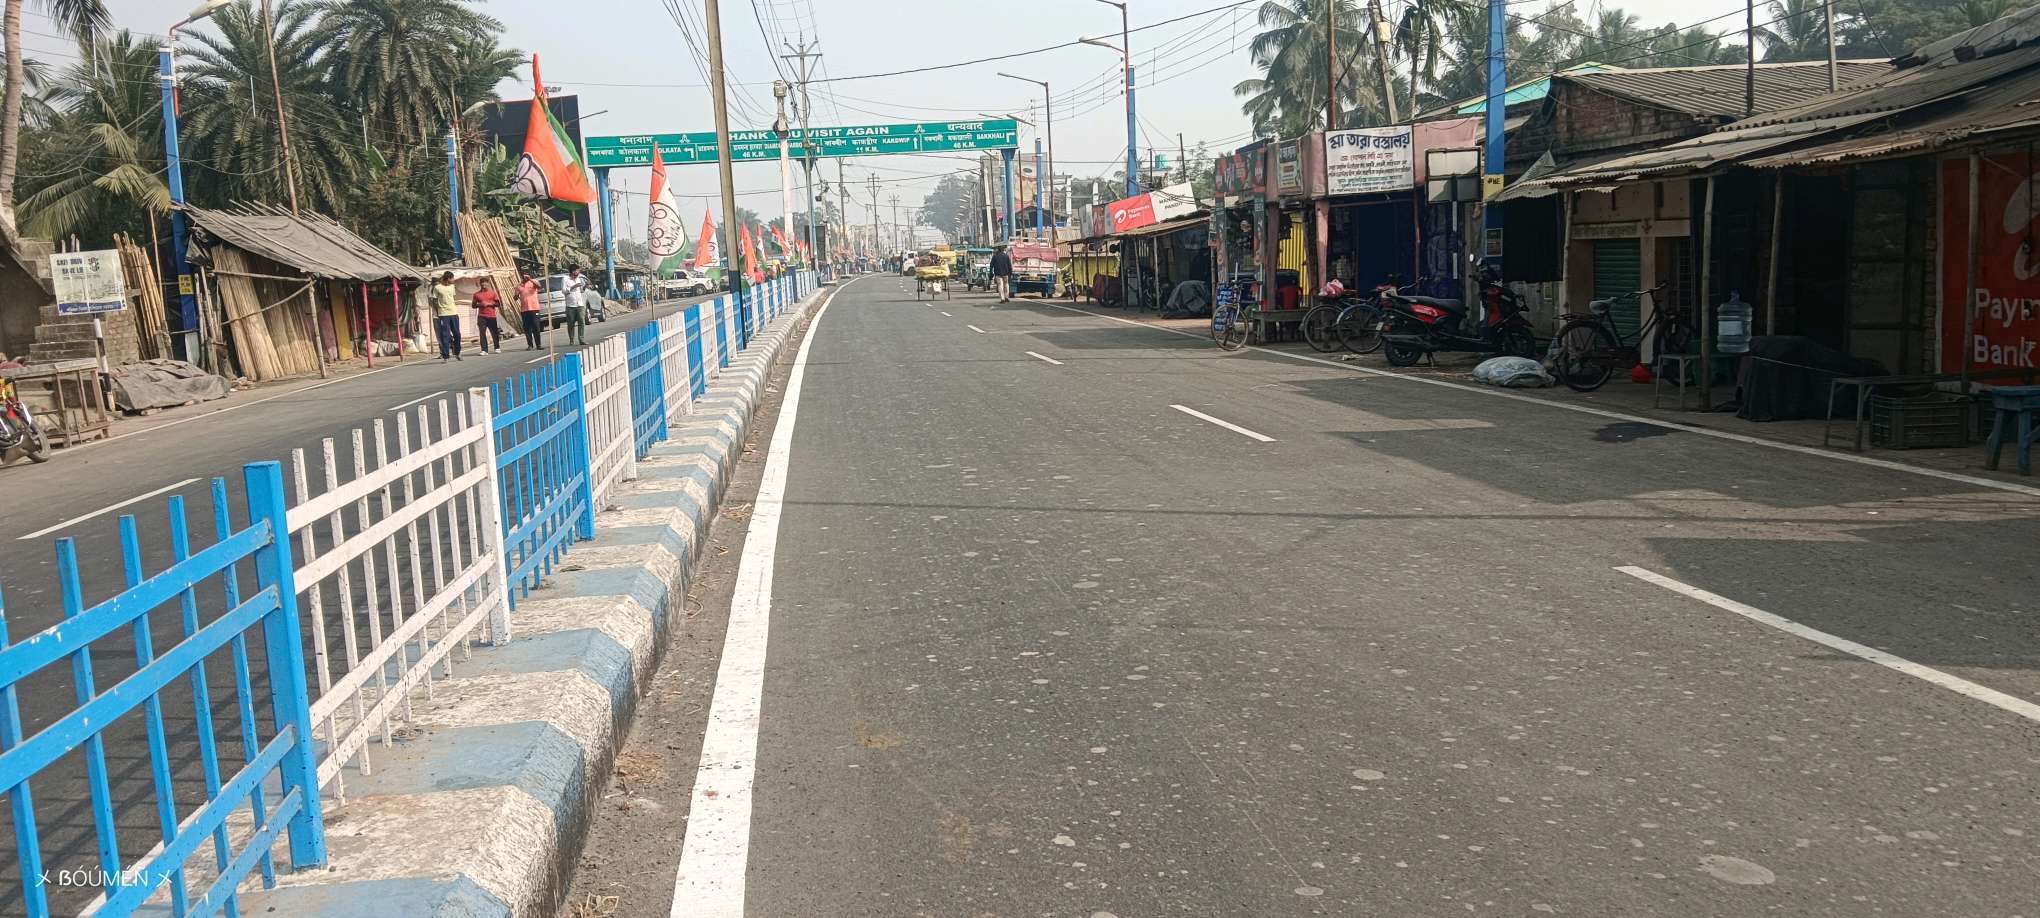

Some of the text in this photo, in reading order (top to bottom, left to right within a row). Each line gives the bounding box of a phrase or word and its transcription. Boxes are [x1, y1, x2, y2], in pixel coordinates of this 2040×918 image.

[728, 132, 768, 140] HANK
[807, 129, 842, 138] VISIT
[846, 127, 889, 136] AGAIN
[1328, 134, 1346, 149] মা
[1346, 134, 1371, 149] তারা
[1973, 333, 2036, 368] Bank
